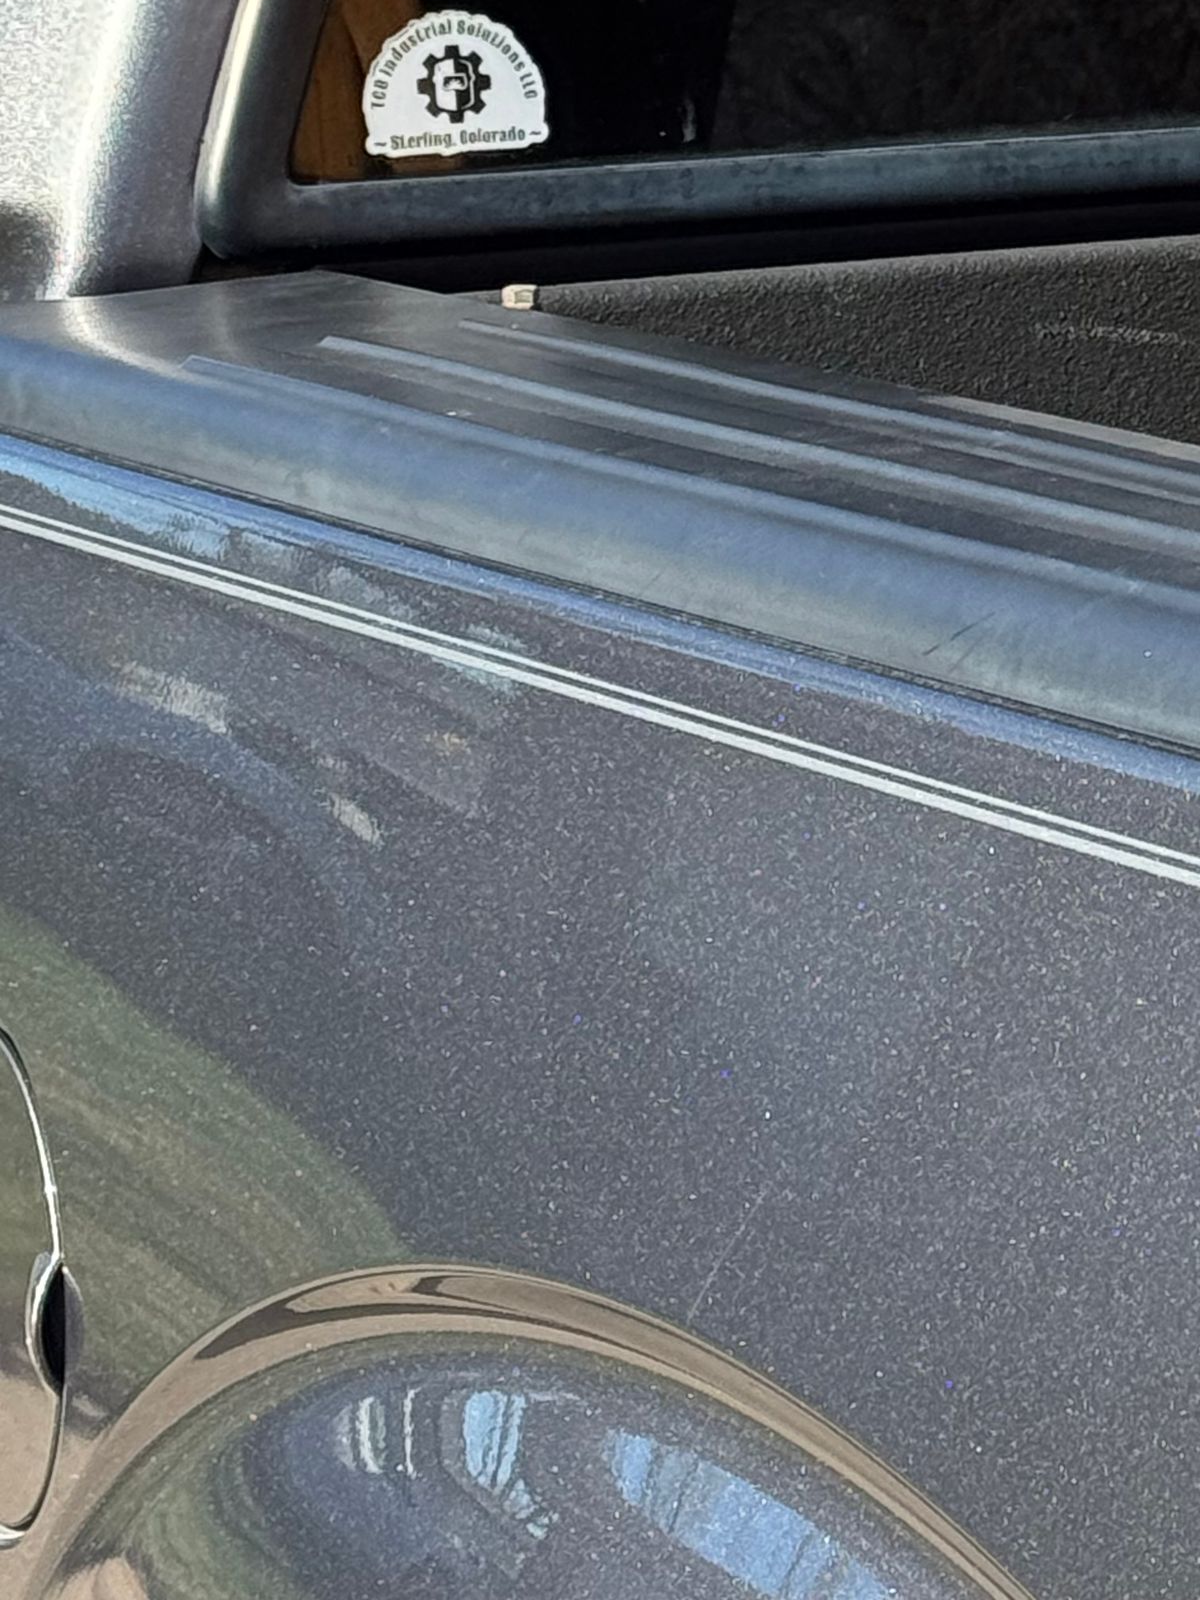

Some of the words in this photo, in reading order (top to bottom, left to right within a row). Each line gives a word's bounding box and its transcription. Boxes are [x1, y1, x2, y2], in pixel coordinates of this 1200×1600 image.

[379, 19, 452, 78] Industrial
[457, 20, 525, 71] Solutions
[519, 72, 538, 99] LLC
[460, 126, 526, 145] Colorado
